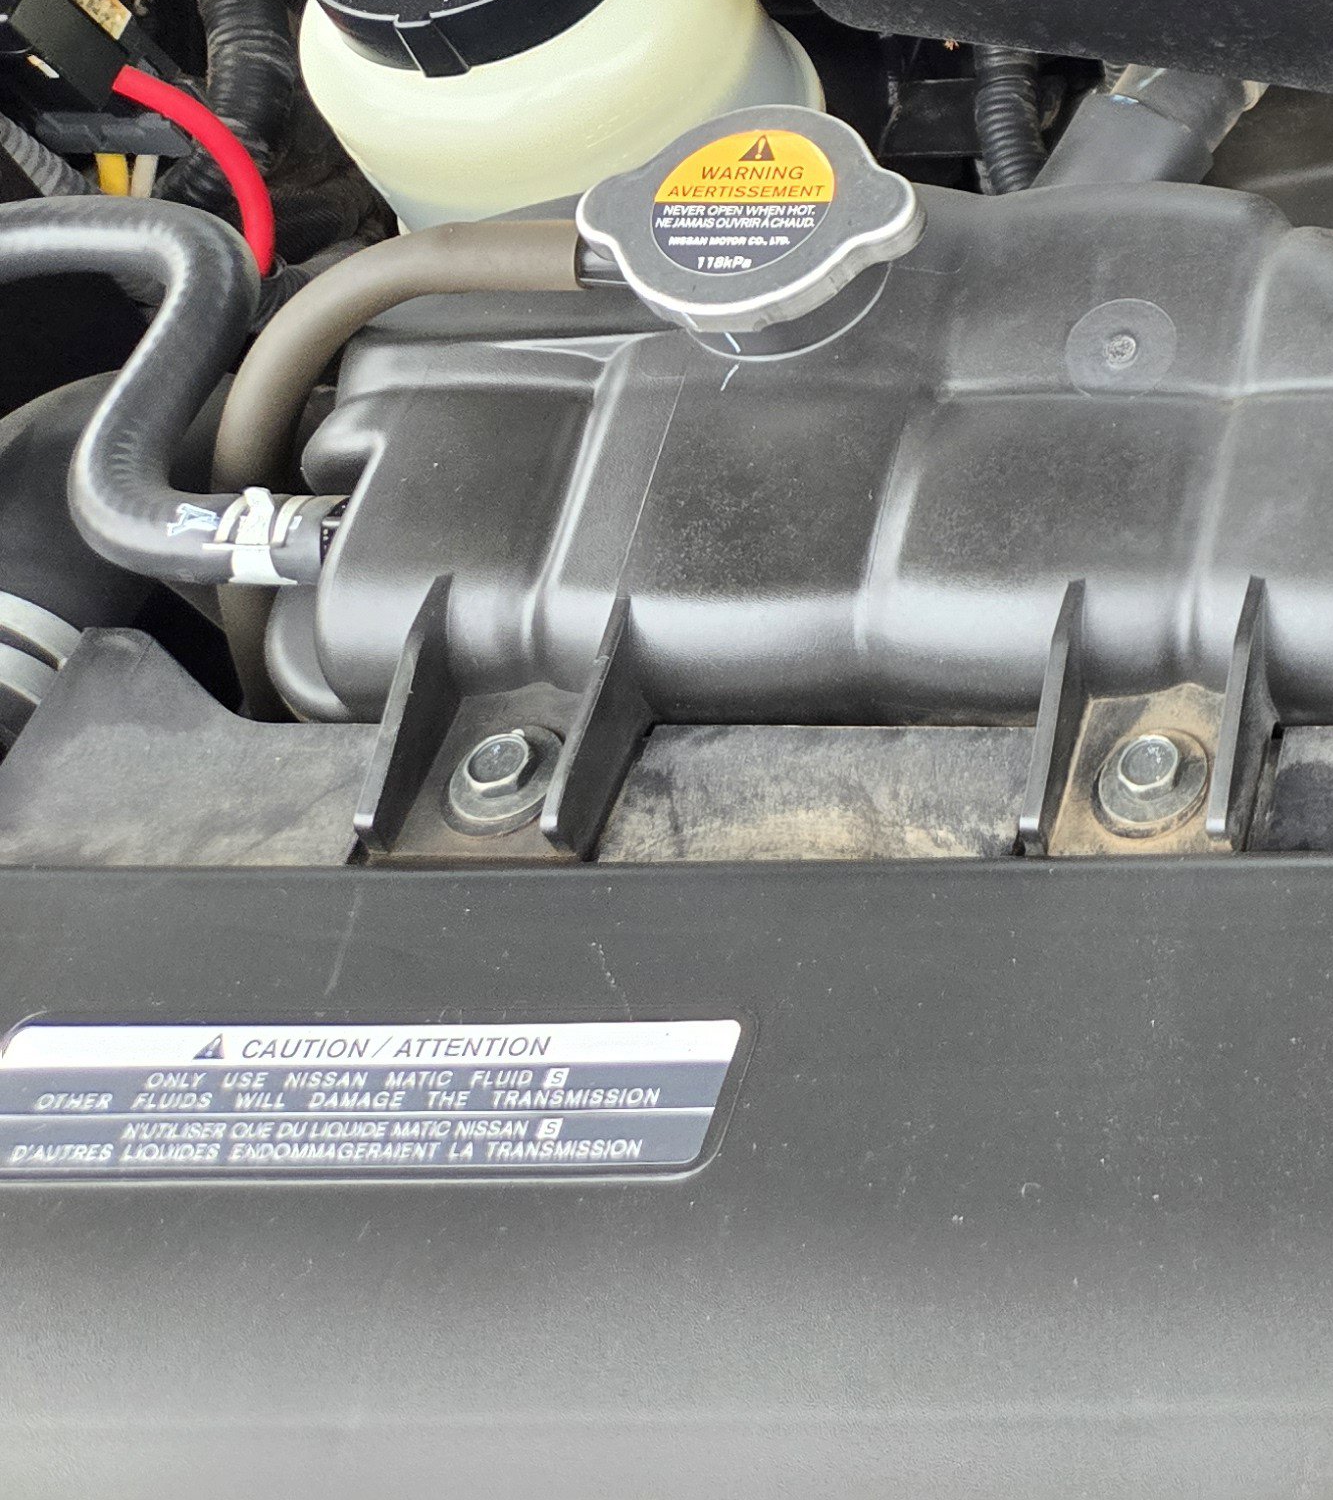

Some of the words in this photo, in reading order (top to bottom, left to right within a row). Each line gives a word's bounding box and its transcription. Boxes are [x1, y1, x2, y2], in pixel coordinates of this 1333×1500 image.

[700, 166, 805, 180] WARNING
[667, 185, 826, 198] AVERTISSEMENT
[662, 205, 706, 216] NEVER
[707, 205, 744, 216] OPEN
[745, 205, 786, 216] WHEN
[787, 205, 816, 216] HOT.
[715, 217, 761, 229] OUVRIR
[770, 217, 815, 229] CHAUD.
[668, 236, 708, 246] NISSAN
[241, 1038, 371, 1059] CAUTION
[392, 1036, 552, 1059] ATTENTION
[145, 1072, 208, 1089] ONLY
[221, 1072, 269, 1089] USE
[283, 1071, 369, 1089] NISSAN
[385, 1070, 454, 1088] MATIC
[470, 1069, 534, 1088] FLUID
[35, 1093, 113, 1110] OTHER
[131, 1092, 213, 1110] FLUIDS
[234, 1092, 285, 1110] WILL
[307, 1091, 406, 1109] DAMAGE
[427, 1090, 470, 1109] THE
[492, 1087, 661, 1109] TRANSMISSION
[119, 1122, 228, 1140] N'UTILISER
[230, 1122, 275, 1140] QUE
[275, 1121, 305, 1139] DU
[310, 1121, 389, 1139] LIQUIDE
[389, 1120, 452, 1139] MATIC
[454, 1120, 529, 1139] NISSAN
[10, 1143, 115, 1162] D'AUTRES
[119, 1143, 221, 1162] LIQUIDES
[227, 1142, 441, 1161] ENDOMMAGERAIENT
[447, 1141, 474, 1160] LA
[485, 1139, 643, 1160] TRANSMISSION
